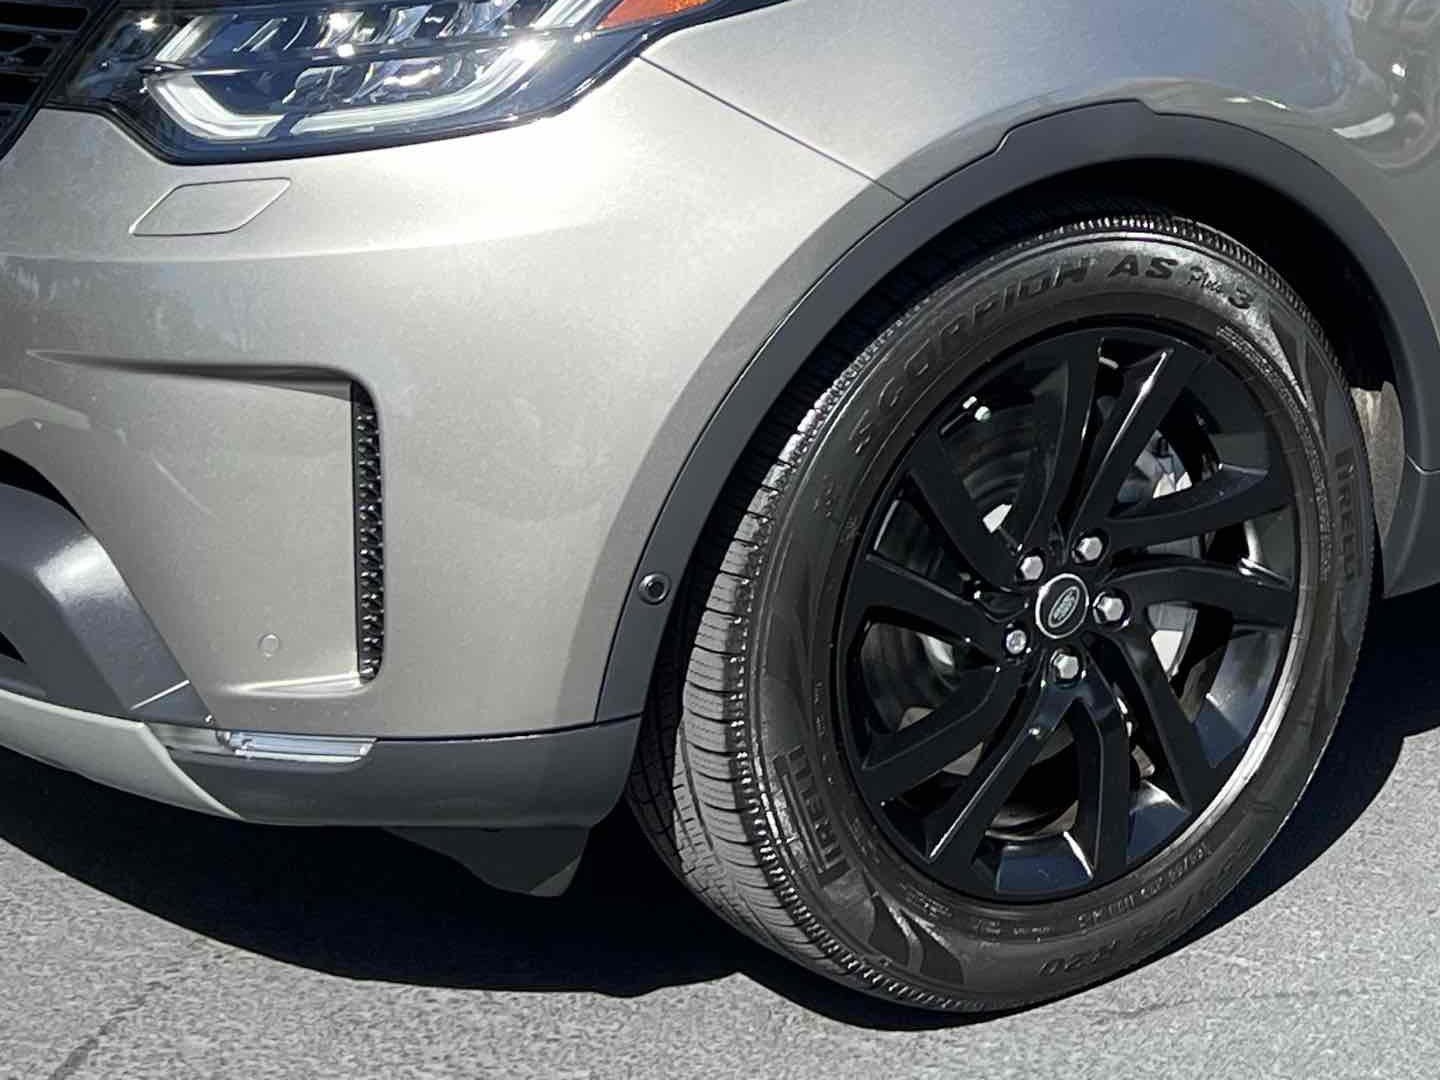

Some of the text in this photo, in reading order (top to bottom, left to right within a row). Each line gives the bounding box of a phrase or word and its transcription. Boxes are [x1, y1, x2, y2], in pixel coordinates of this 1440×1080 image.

[848, 255, 1097, 455] SCORPION
[1108, 254, 1178, 279] AS
[1228, 286, 1256, 310] 3
